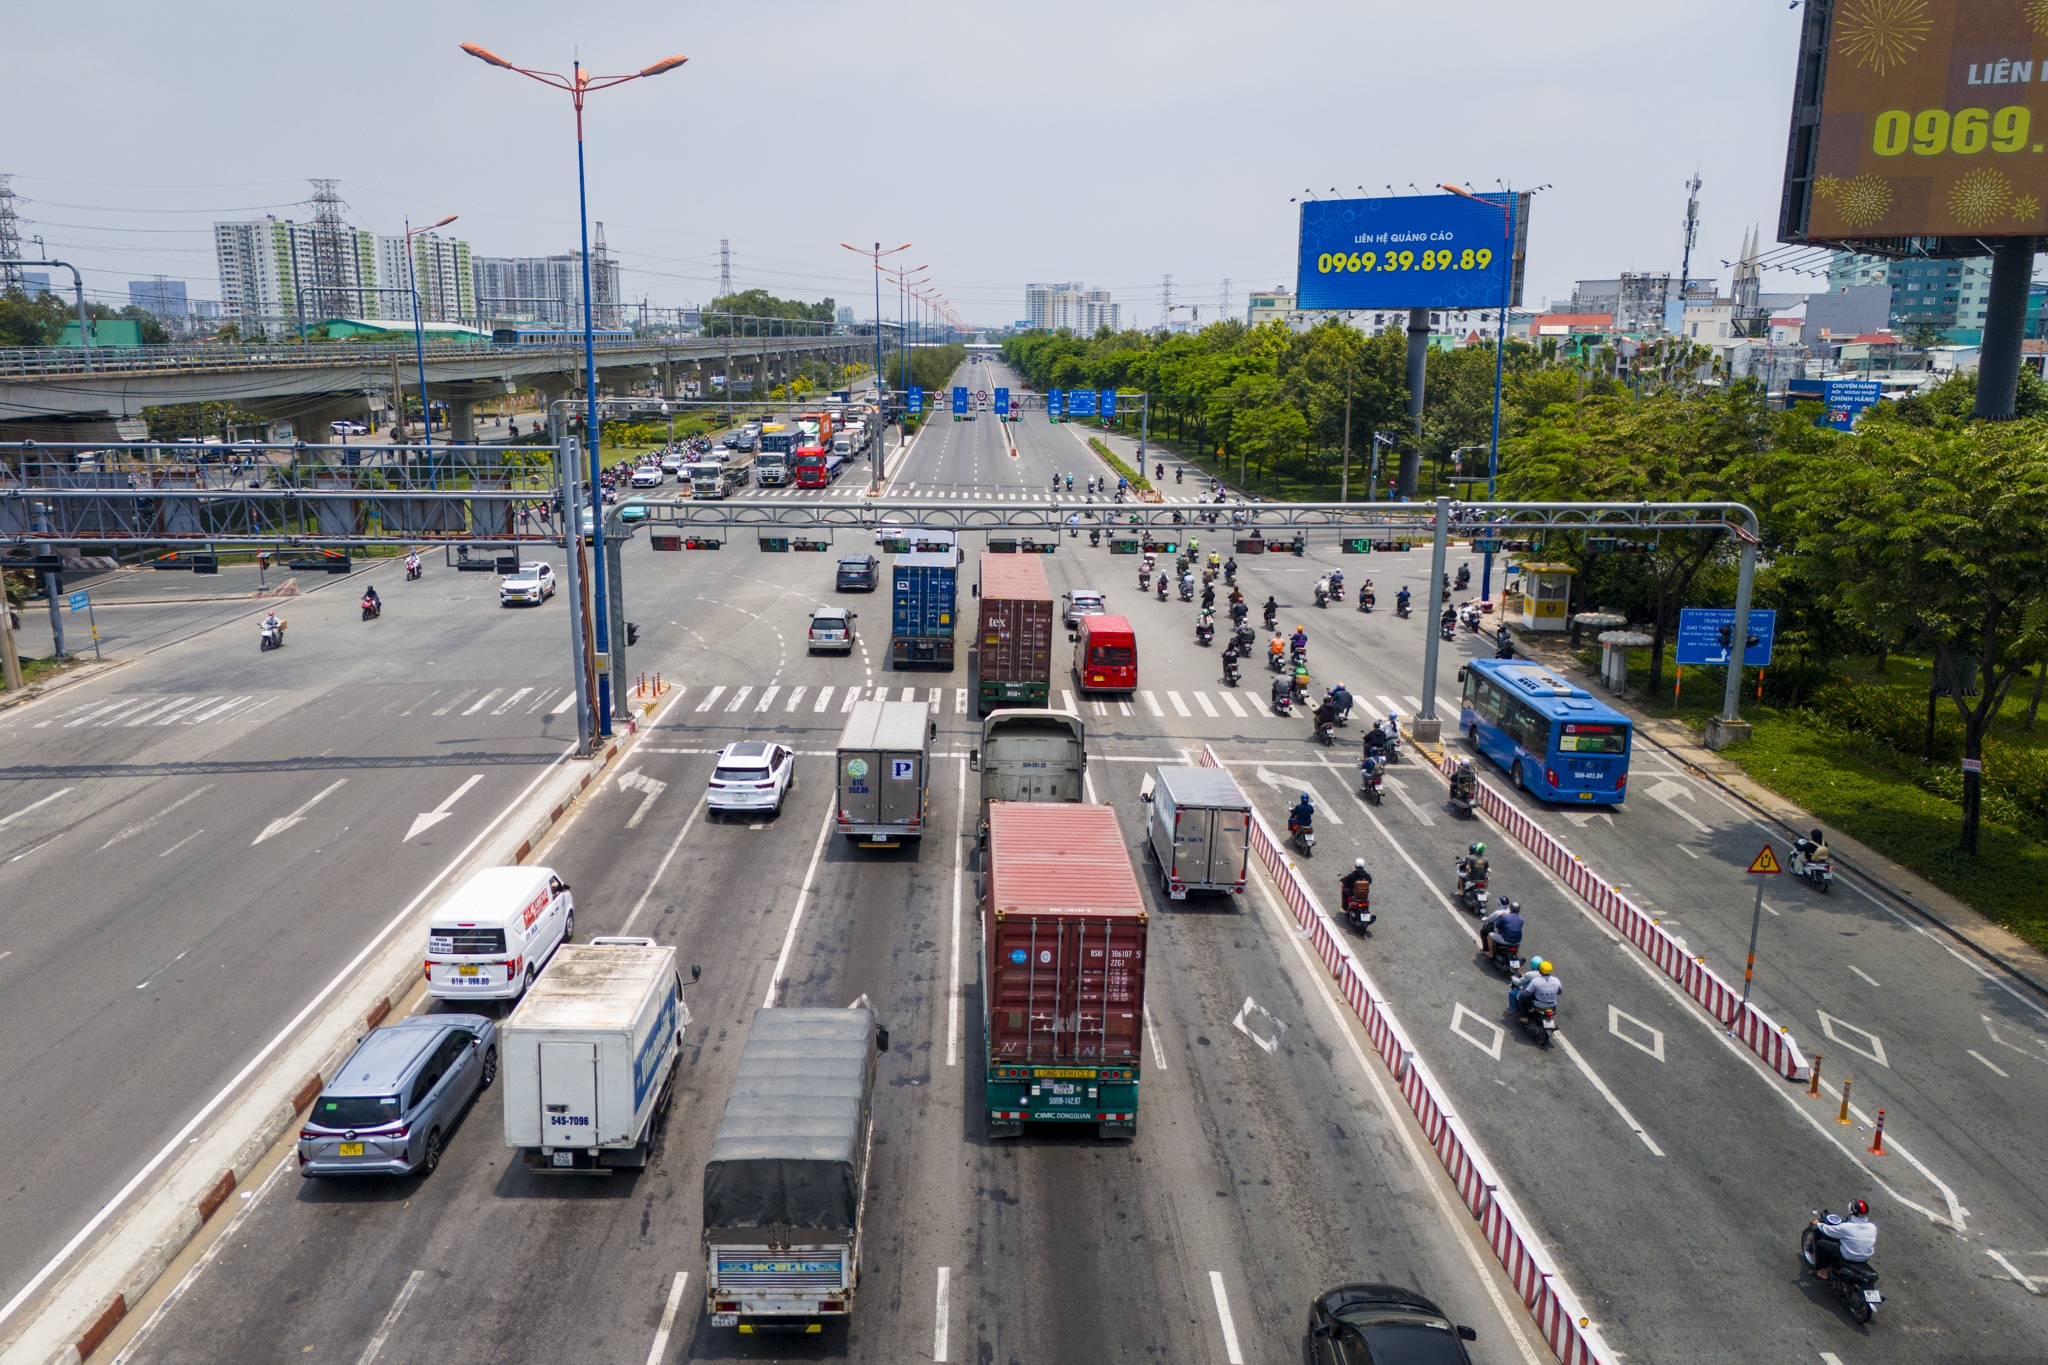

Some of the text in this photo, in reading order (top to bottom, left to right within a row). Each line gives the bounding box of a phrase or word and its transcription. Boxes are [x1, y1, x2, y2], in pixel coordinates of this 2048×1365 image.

[1967, 58, 2033, 85] LIÊN
[1355, 230, 1454, 244] LIÊN HỆ QUẢNG CÁO
[1318, 248, 1492, 273] 0969.39.89.89
[1351, 539, 1369, 552] 40
[989, 616, 1006, 628] tex
[551, 1116, 589, 1126] 54S-7096
